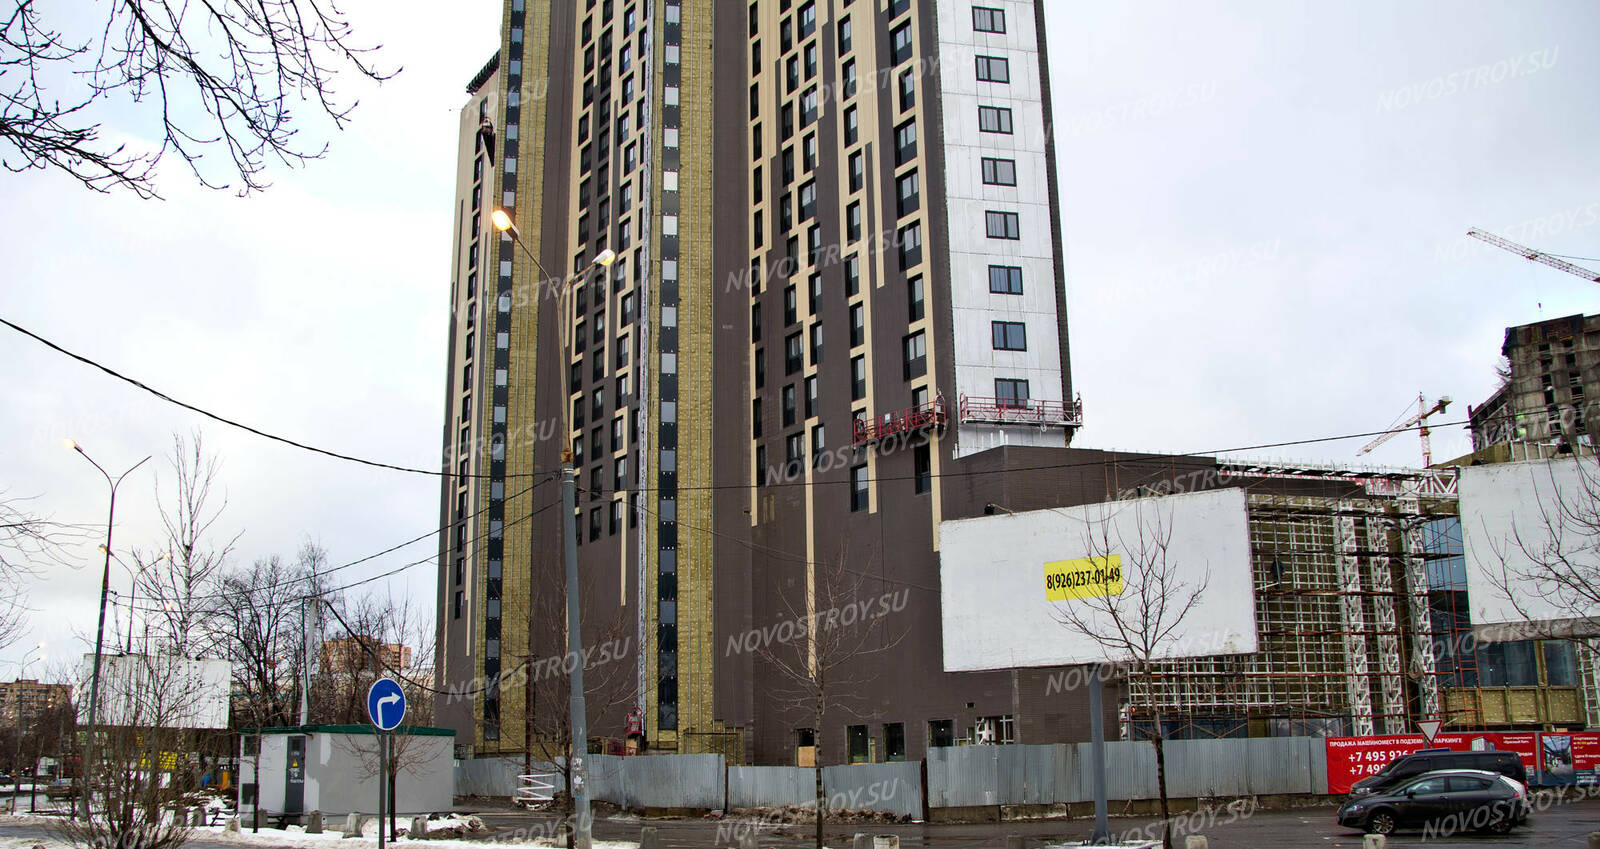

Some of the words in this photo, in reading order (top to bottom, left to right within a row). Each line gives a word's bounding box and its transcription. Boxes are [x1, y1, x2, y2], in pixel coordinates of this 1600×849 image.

[1349, 751, 1362, 762] +7
[1365, 750, 1386, 761] 495
[1350, 764, 1364, 775] +7
